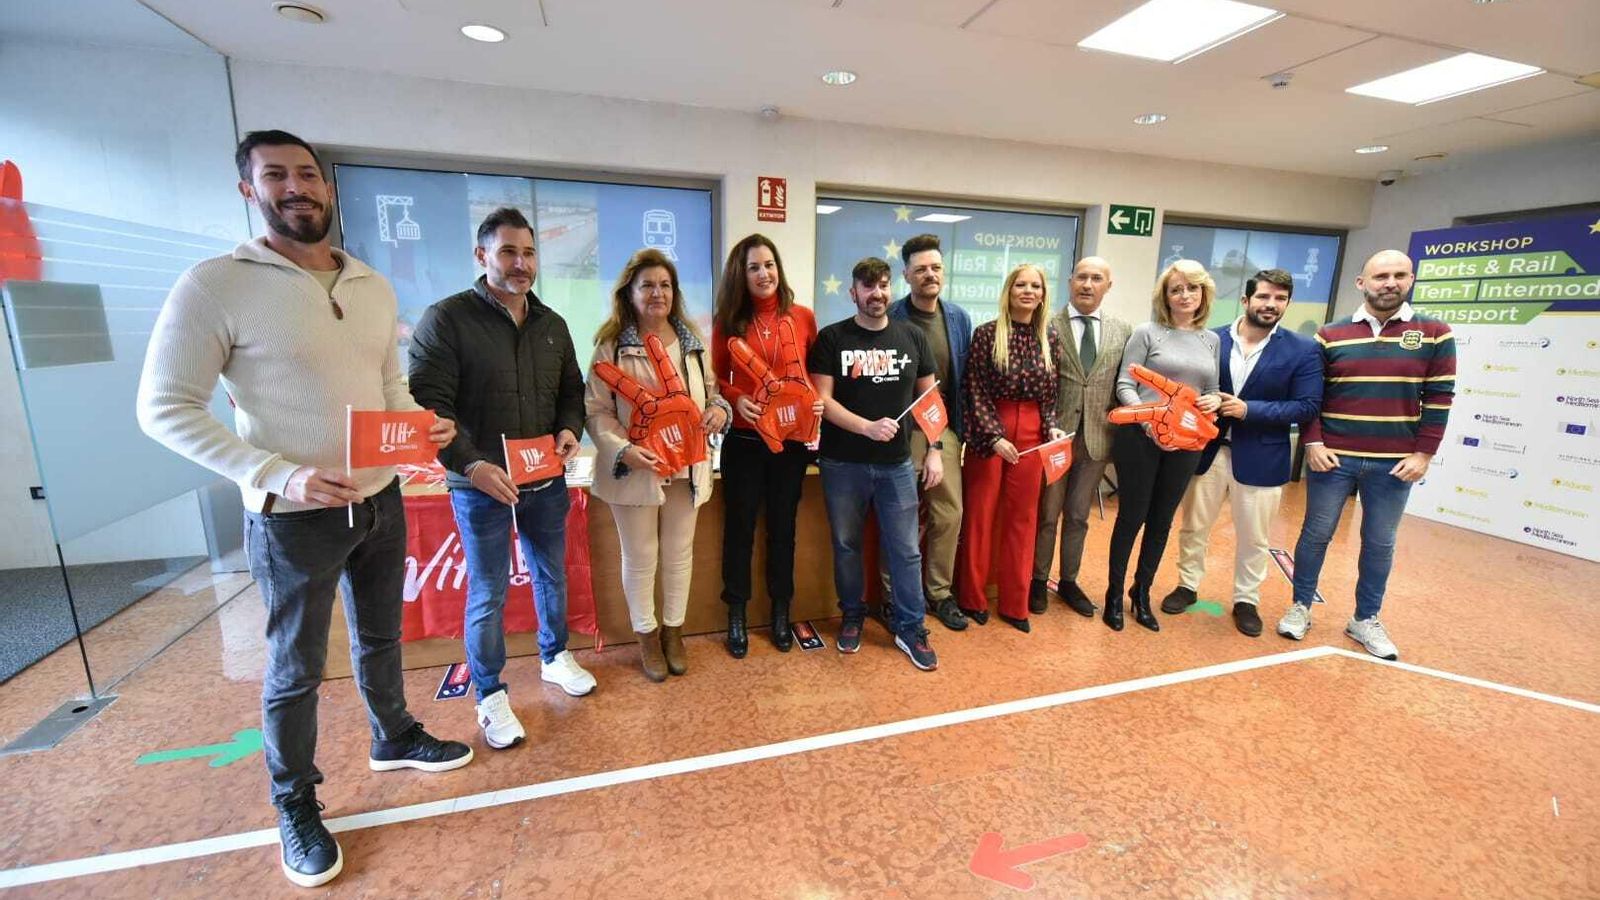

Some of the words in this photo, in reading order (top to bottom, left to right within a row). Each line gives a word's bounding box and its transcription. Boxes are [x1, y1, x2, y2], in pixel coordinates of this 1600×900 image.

[1425, 236, 1534, 256] WORKSHOP
[1421, 262, 1477, 278] Ports
[1484, 259, 1500, 275] &
[1508, 255, 1557, 273] Rail
[1418, 283, 1476, 299] Ten-T
[381, 422, 418, 444] VIH+
[519, 448, 545, 466] VIH+
